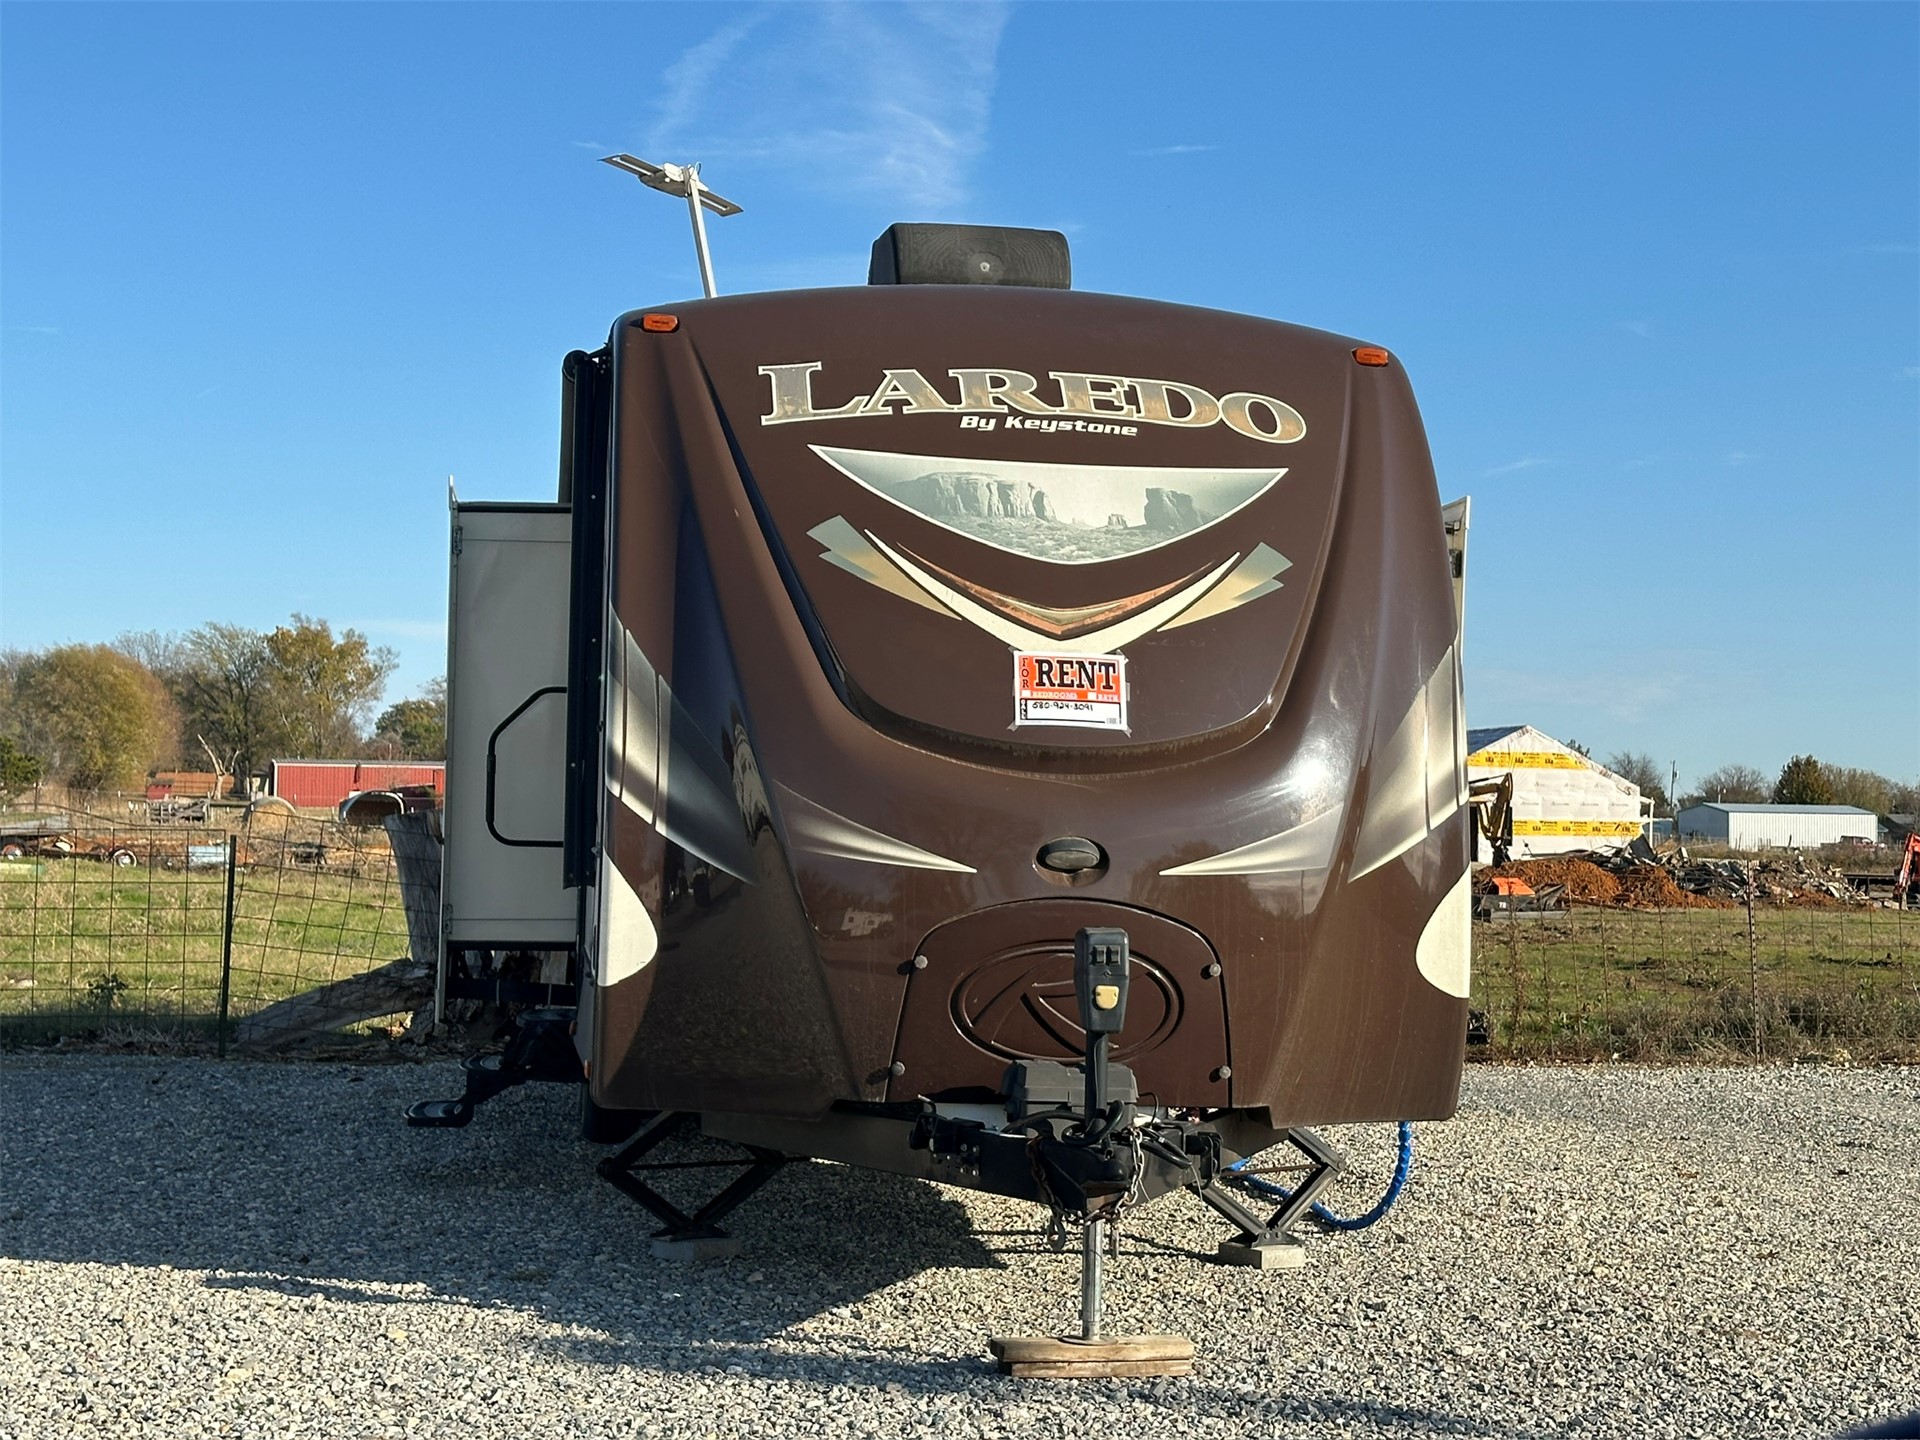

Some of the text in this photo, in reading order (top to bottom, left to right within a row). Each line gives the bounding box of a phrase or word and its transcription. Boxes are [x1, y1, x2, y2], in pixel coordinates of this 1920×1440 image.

[758, 360, 1307, 444] LAREDO
[960, 415, 1138, 437] By Keystone
[1021, 658, 1030, 688] FOR
[1035, 658, 1116, 690] RENT
